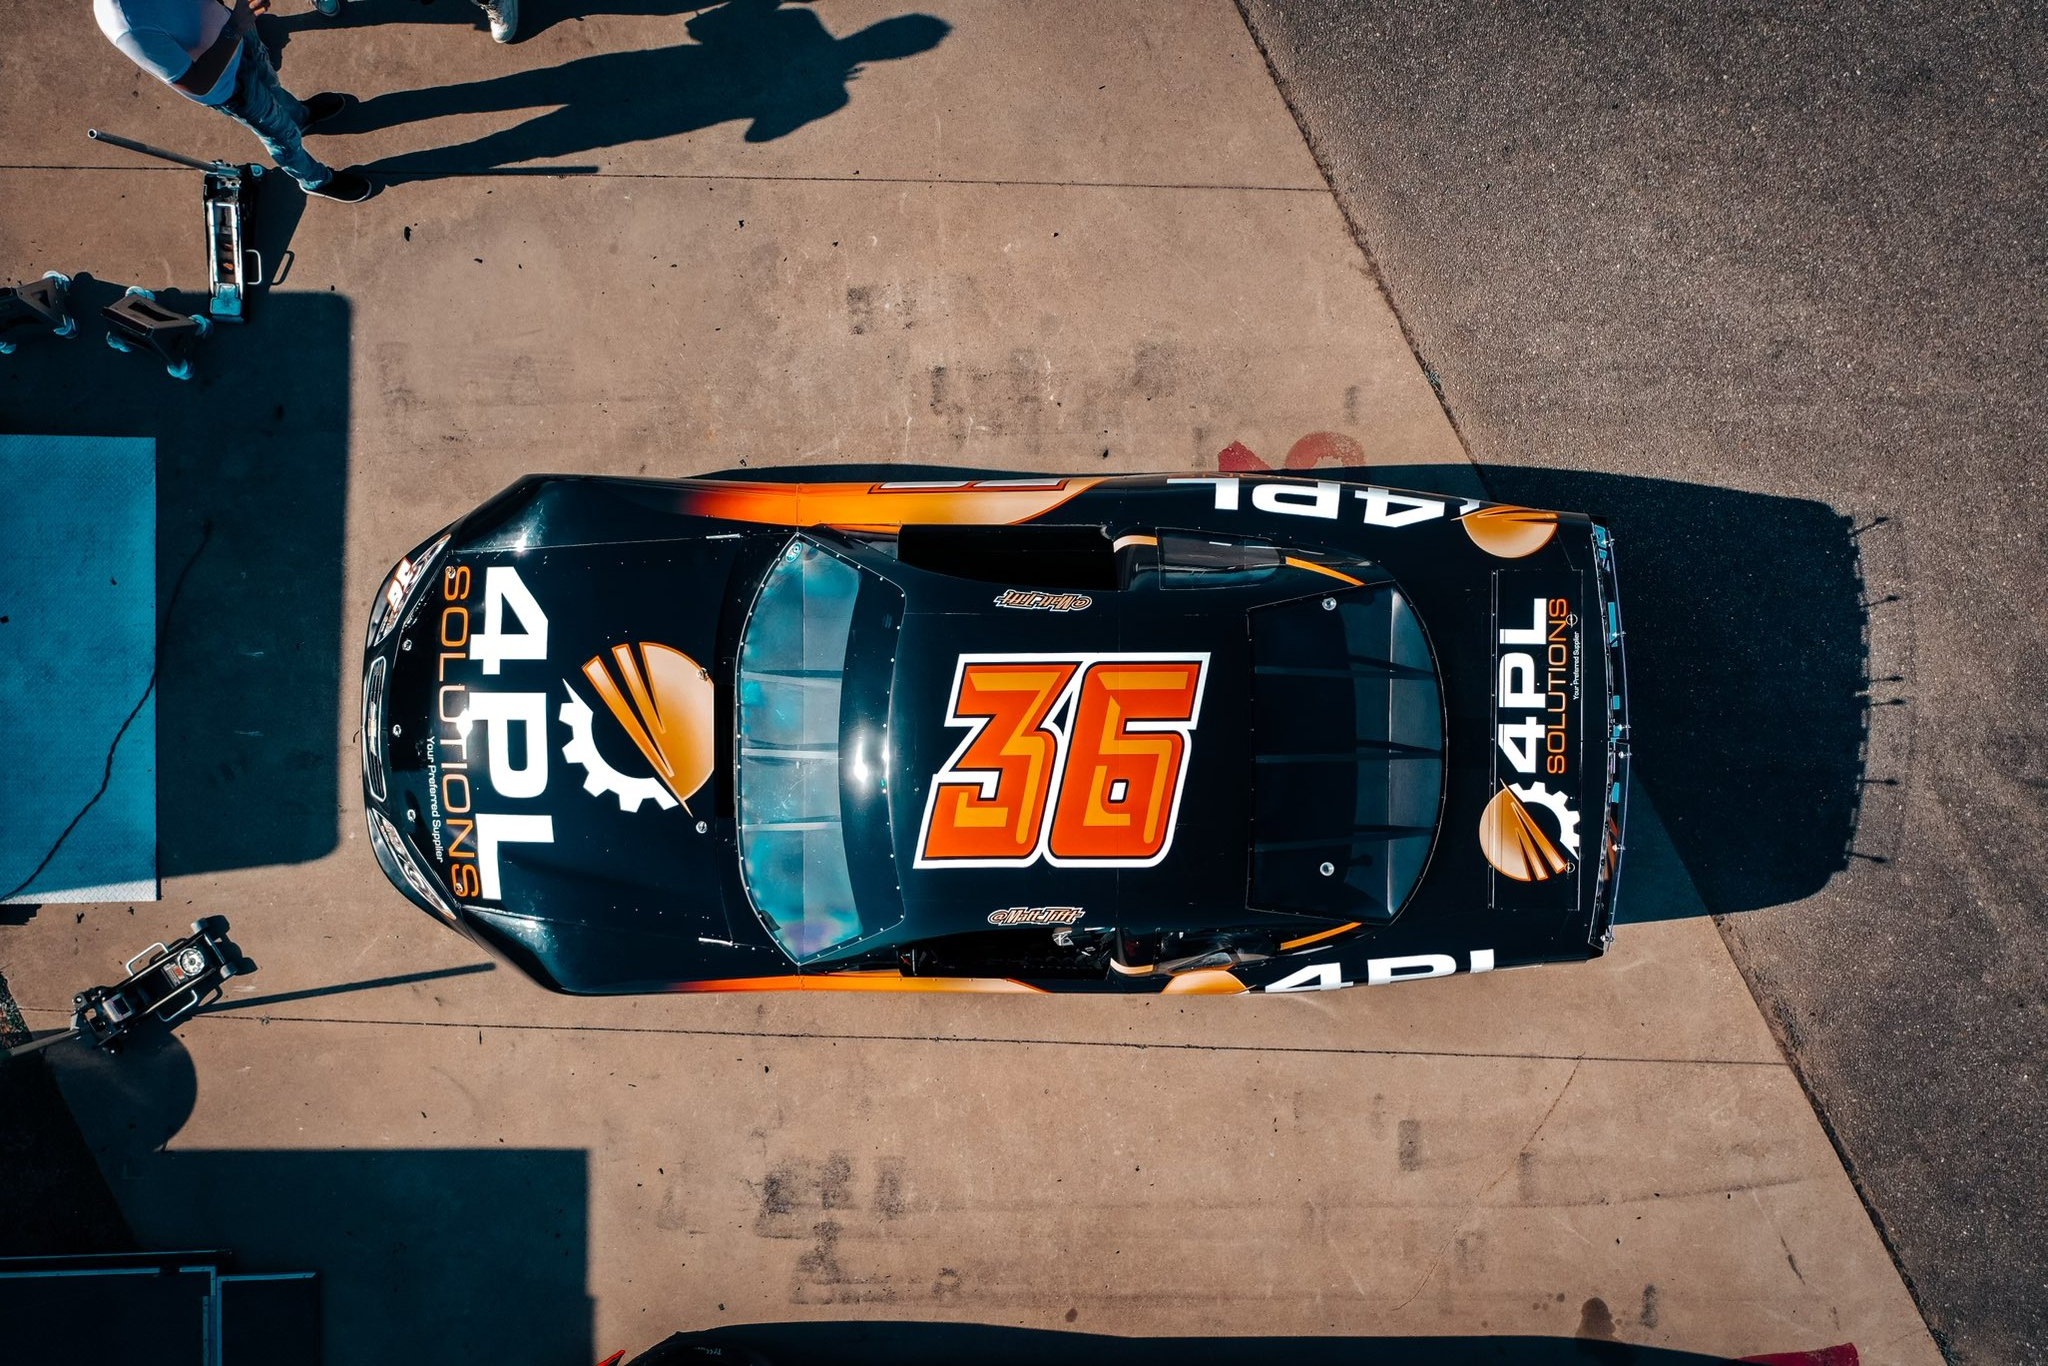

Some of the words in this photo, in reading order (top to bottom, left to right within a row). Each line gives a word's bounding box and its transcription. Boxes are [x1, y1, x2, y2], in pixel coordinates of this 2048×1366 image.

[1167, 478, 1446, 528] 4PL
[1572, 631, 1581, 656] Supplier
[1498, 598, 1547, 774] 4PL
[1547, 598, 1568, 774] SOLUTIONS
[1572, 656, 1580, 685] Preferred
[1572, 685, 1580, 701] Your
[426, 735, 437, 763] Your
[438, 566, 480, 898] SOLUTIONS
[469, 566, 555, 901] 4PL
[913, 651, 1212, 870] 36
[427, 765, 441, 818] Preferred
[432, 819, 444, 864] Supplier
